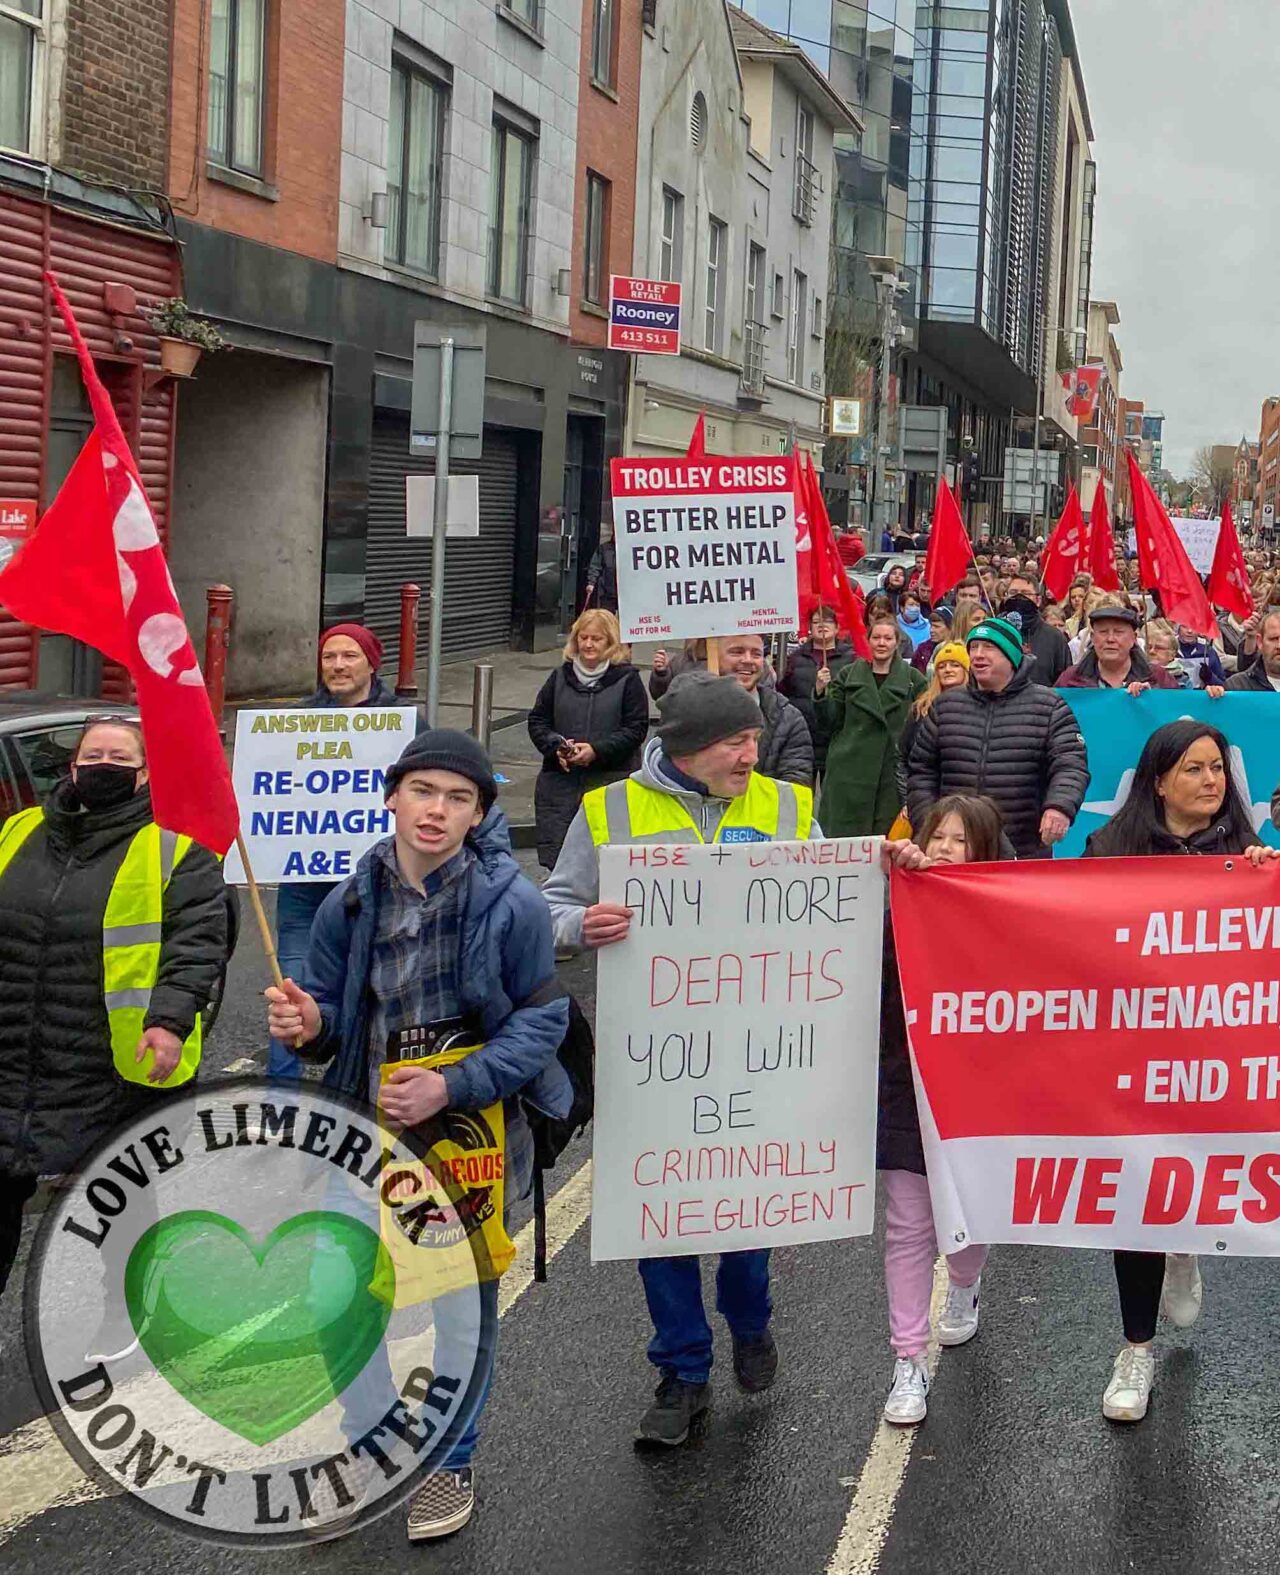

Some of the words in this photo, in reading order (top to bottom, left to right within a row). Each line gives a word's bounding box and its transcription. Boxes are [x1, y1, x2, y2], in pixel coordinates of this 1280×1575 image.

[628, 280, 644, 291] TO
[647, 283, 668, 295] LET
[630, 290, 663, 301] RETAIL
[616, 304, 675, 325] Rooney
[620, 331, 643, 342] 413
[646, 333, 668, 344] 511
[620, 466, 713, 489] TROLLEY
[718, 465, 786, 487] CRISIS
[625, 506, 719, 533] BETTER
[726, 505, 786, 530] HELP
[632, 545, 680, 570] FOR
[688, 541, 785, 568] MENTAL
[666, 578, 755, 606] HEALTH
[639, 616, 652, 624] HSE
[654, 615, 661, 623] IS
[737, 619, 762, 628] HEALTH
[763, 617, 793, 627] MATTERS
[752, 608, 778, 616] MENTAL
[629, 627, 644, 636] NOT
[646, 626, 659, 635] FOR
[660, 625, 671, 633] ME
[251, 713, 348, 733] ANSWER
[353, 713, 402, 731] OUR
[296, 741, 353, 760] PLEA
[252, 769, 386, 796] RE-OPEN
[251, 809, 389, 836] NENAGH
[283, 850, 352, 876] A&E
[629, 846, 691, 867] HSE
[625, 877, 701, 927] ANY
[746, 875, 859, 925] MORE
[651, 949, 844, 1008] DEATHS
[930, 989, 1098, 1035] REOPEN
[628, 1031, 711, 1086] YOU
[1144, 1060, 1229, 1104] END
[693, 1091, 756, 1135] BE
[634, 1139, 837, 1187] CRIMINALLY
[1011, 1157, 1124, 1226] WE
[641, 1184, 867, 1241] NEGLIGENT
